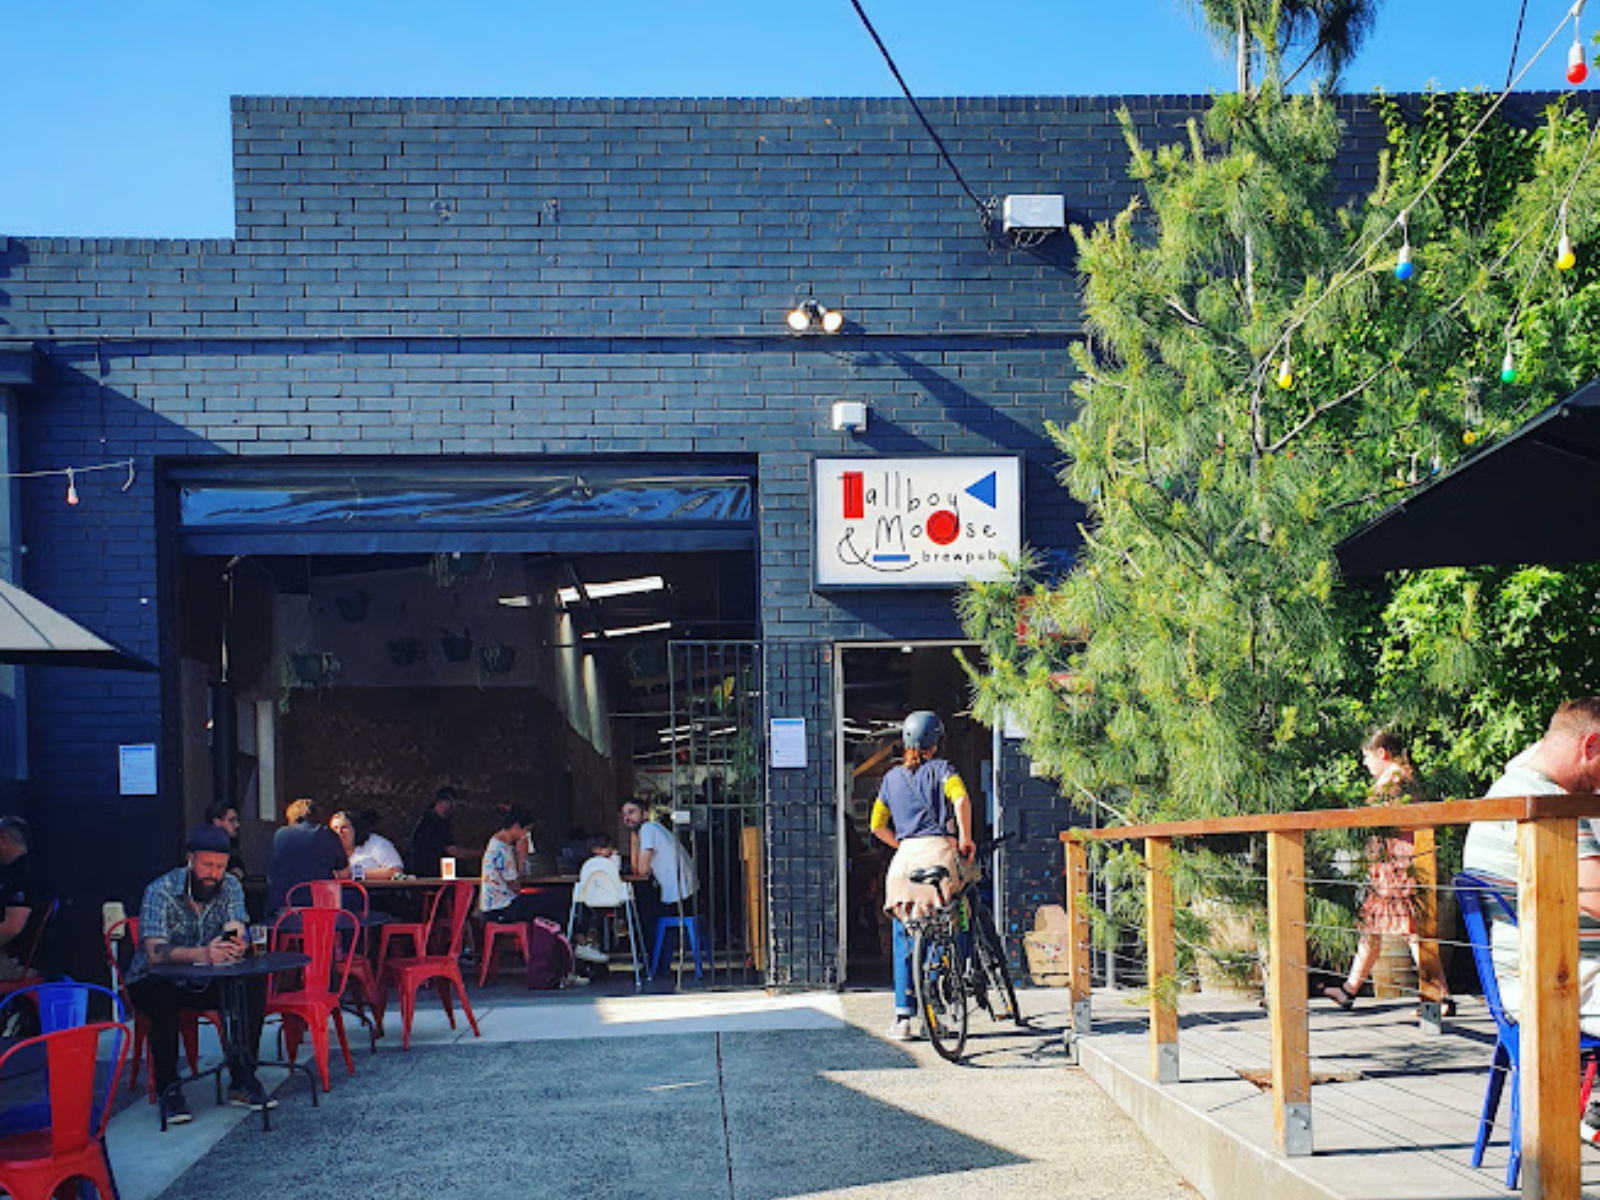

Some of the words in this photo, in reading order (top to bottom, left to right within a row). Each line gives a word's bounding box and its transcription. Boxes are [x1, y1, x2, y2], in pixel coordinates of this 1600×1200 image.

[837, 471, 960, 526] Tallboy
[837, 527, 918, 571] &
[875, 514, 996, 552] Moose
[922, 549, 997, 564] brewpub
